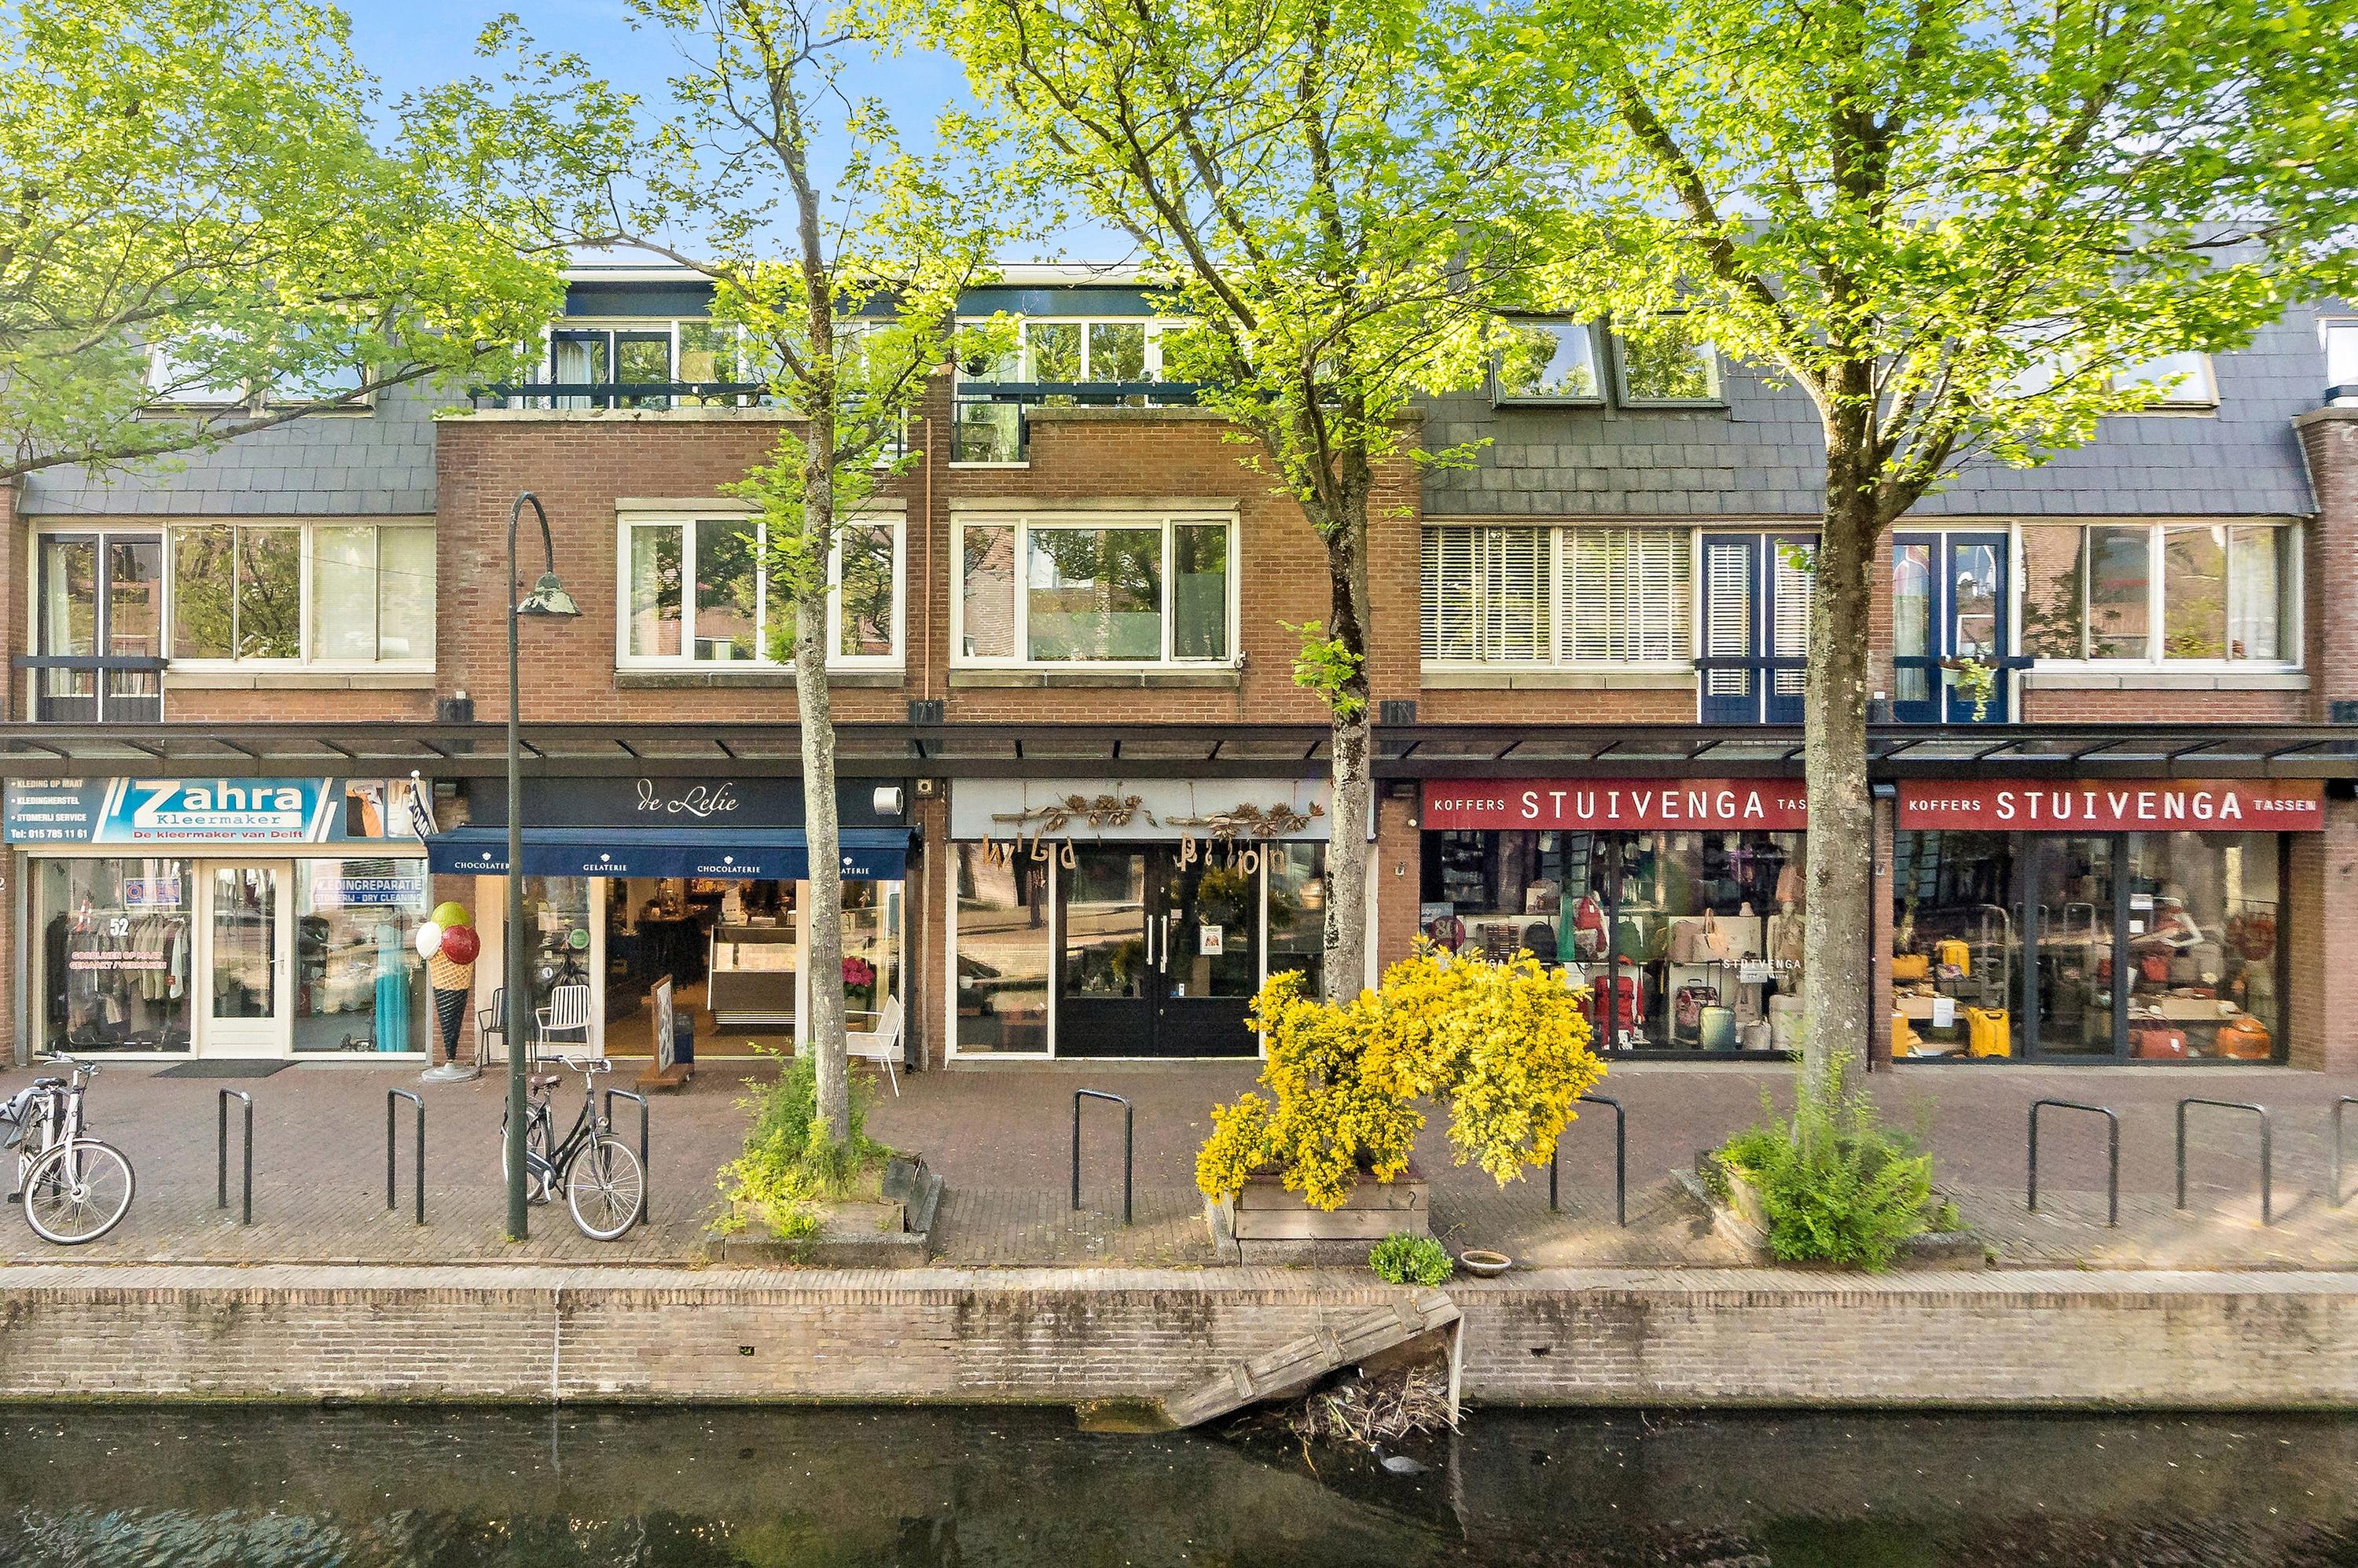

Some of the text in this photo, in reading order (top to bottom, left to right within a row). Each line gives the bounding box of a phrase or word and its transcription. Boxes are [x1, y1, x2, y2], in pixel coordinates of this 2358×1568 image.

[17, 796, 79, 805] KLEDINGHERSTEL
[637, 778, 739, 817] de Lelie
[134, 780, 303, 828] Zahra
[1434, 791, 1806, 819] KOFFERS STUIVENGA TAS
[1908, 791, 2316, 819] KOFFERS STUIVENGA TASSEN
[17, 813, 87, 822] STOMERIJ SERVICE
[156, 814, 281, 824] Kleermaker
[10, 829, 27, 839] Tel:
[28, 829, 46, 839] 015
[64, 829, 75, 839] 11
[77, 829, 88, 839] 61
[362, 894, 378, 902] DRY
[380, 894, 423, 903] CLEANING
[110, 918, 129, 936] 52
[72, 951, 162, 960] GORDIJNEN OP MAAT
[69, 961, 112, 970] GEMAAKT
[1723, 959, 1802, 969] STUIVENGA
